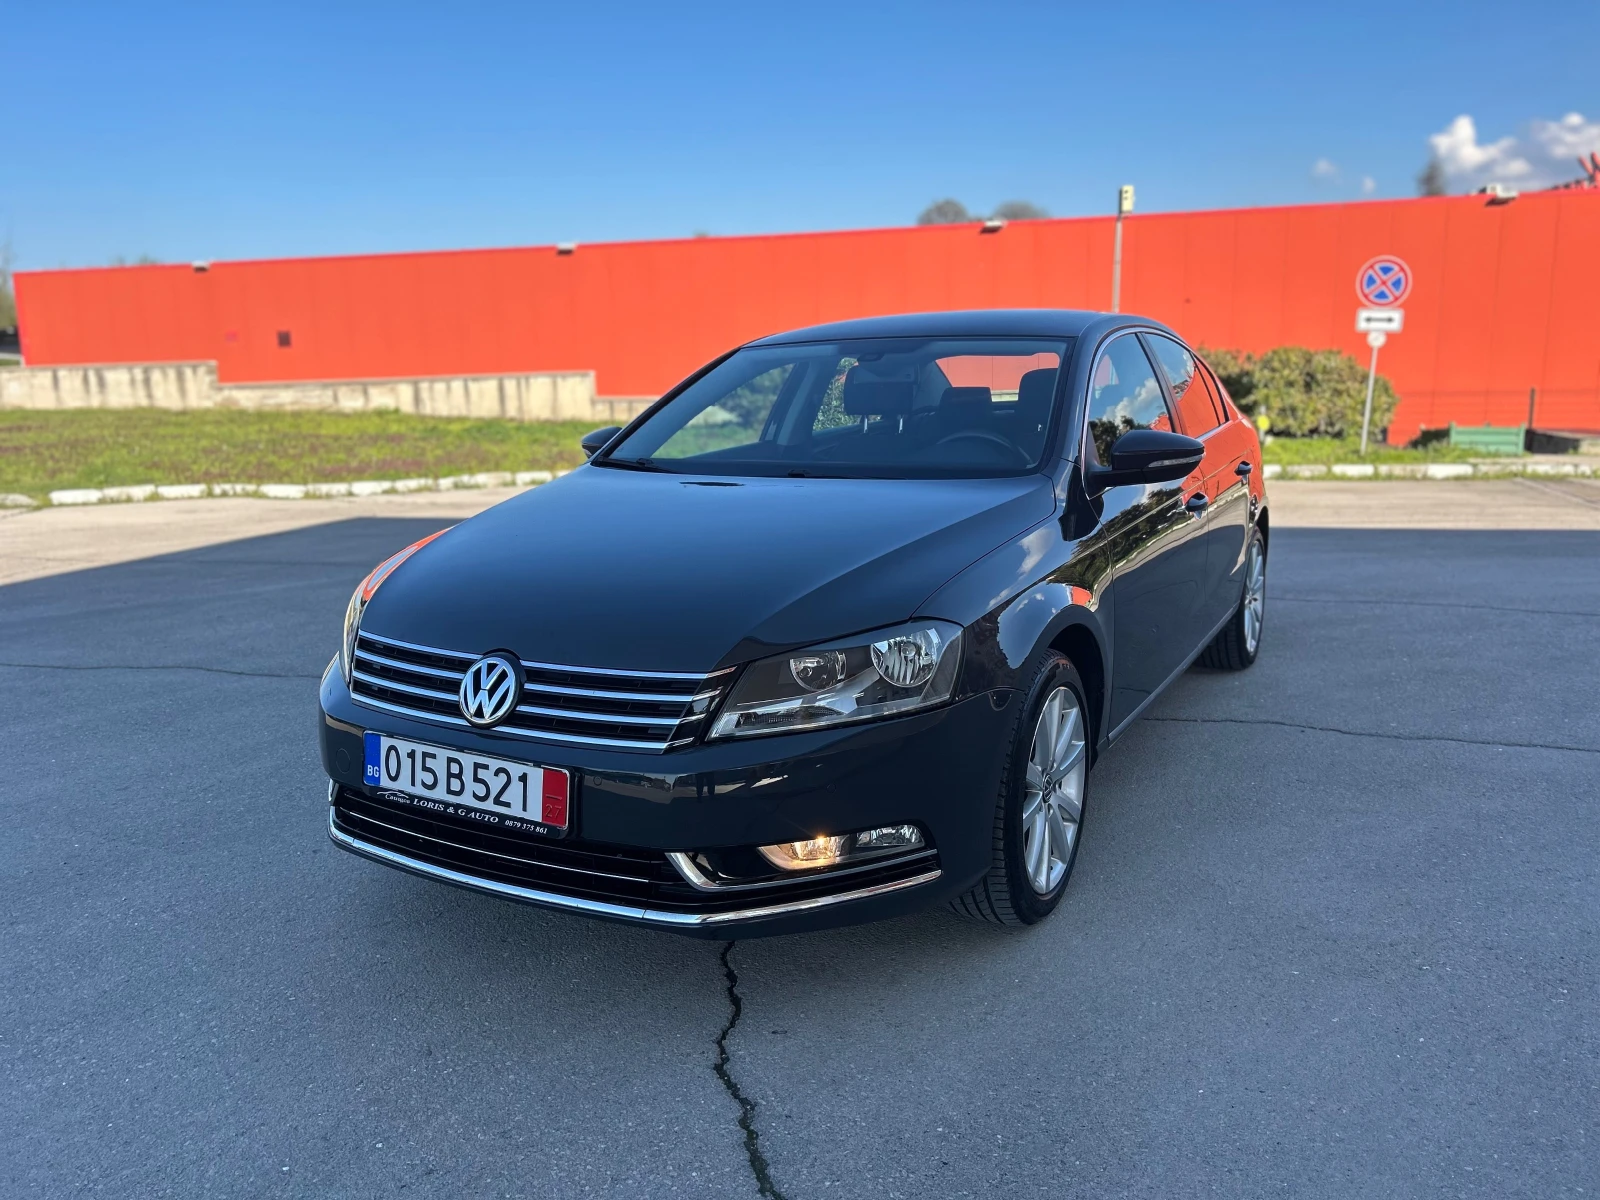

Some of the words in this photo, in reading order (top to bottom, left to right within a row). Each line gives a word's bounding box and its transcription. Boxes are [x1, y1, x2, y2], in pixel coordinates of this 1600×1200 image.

[460, 657, 515, 723] VW
[367, 764, 380, 778] BG
[385, 745, 528, 812] 015B521
[413, 798, 444, 811] LORIS
[447, 806, 455, 814] &
[458, 808, 466, 816] G
[468, 811, 499, 823] AUTO
[505, 819, 521, 828] 0879
[535, 826, 548, 835] 861
[545, 803, 562, 818] 27
